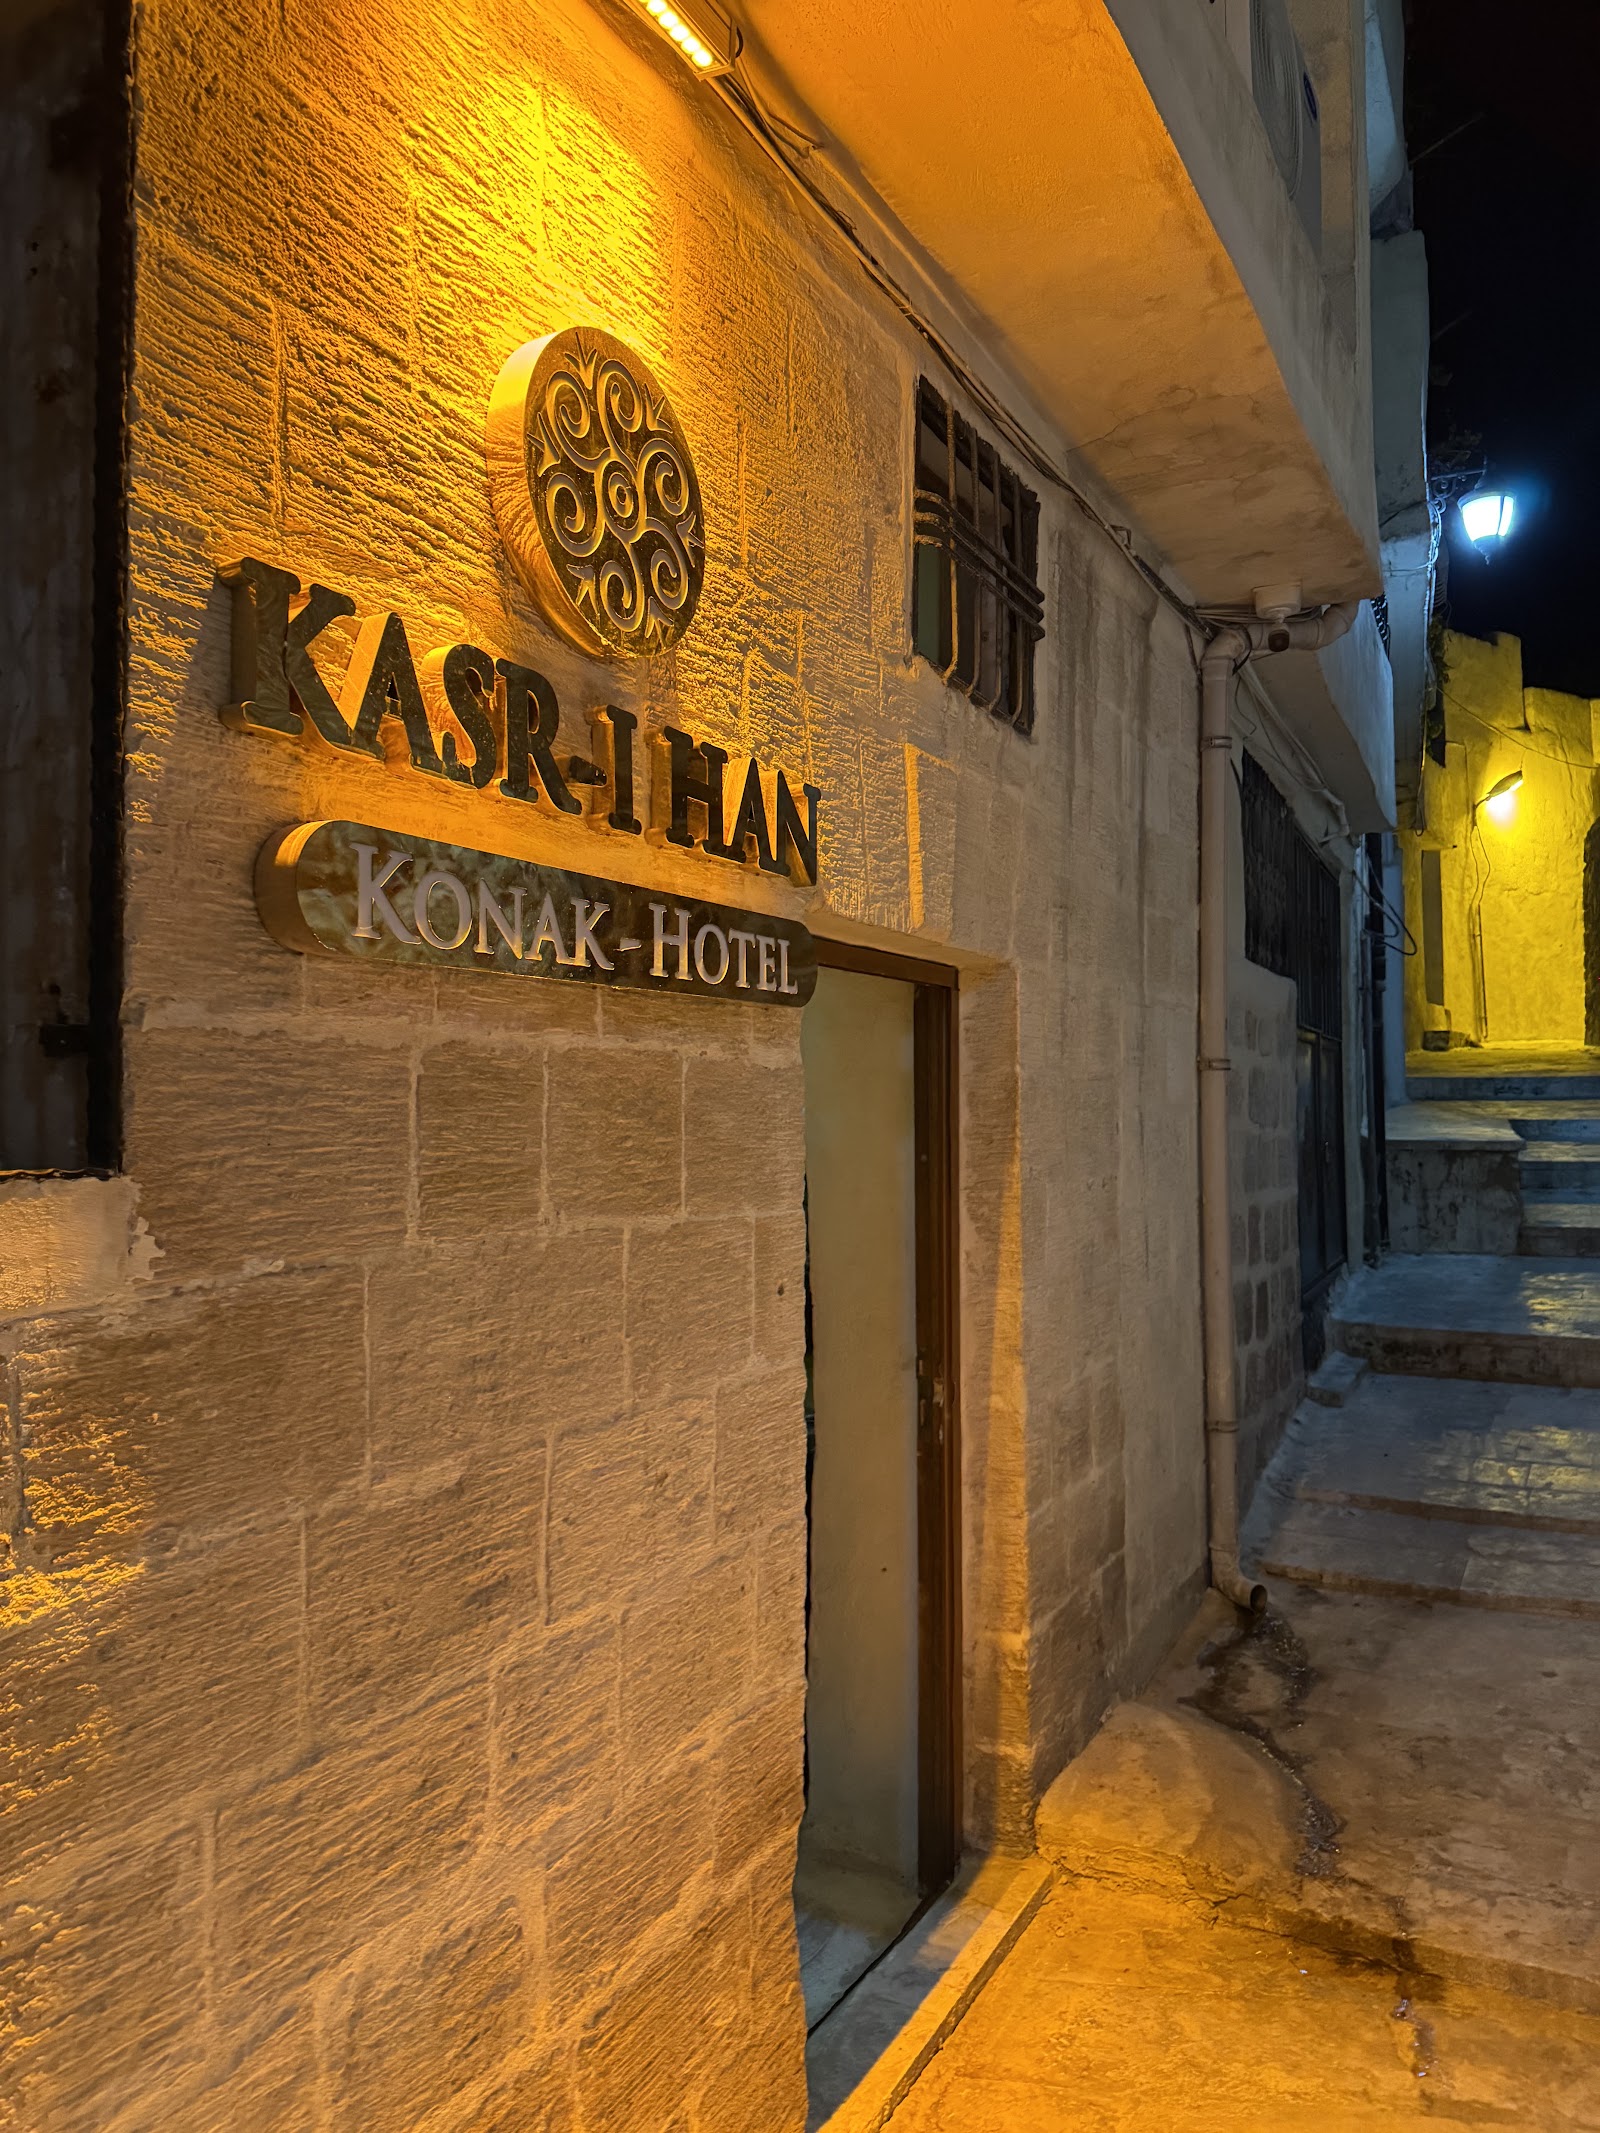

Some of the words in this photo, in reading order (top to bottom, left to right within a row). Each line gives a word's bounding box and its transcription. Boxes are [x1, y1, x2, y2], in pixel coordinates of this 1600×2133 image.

[240, 557, 641, 835] KASR-I
[663, 726, 820, 886] HAN
[350, 843, 615, 970] KONAK
[650, 903, 799, 995] HOTEL
